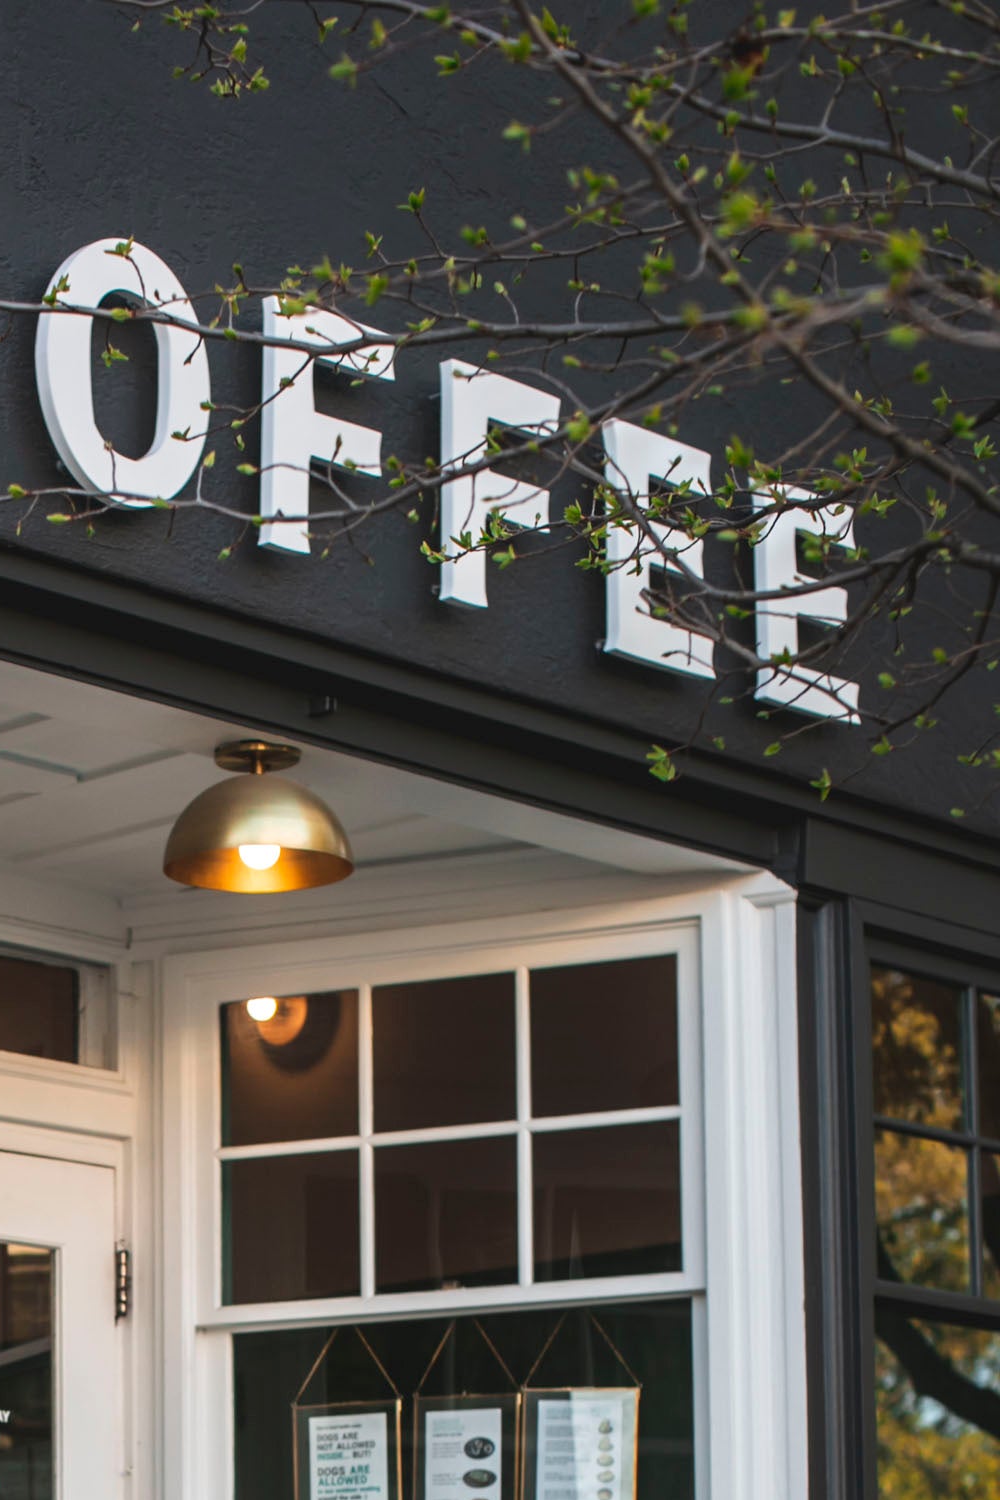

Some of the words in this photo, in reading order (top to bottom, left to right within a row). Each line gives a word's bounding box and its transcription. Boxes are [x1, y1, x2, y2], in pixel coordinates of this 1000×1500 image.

[317, 1432, 339, 1441] DOGS
[342, 1431, 359, 1440] ARE
[317, 1442, 333, 1451] NOT
[337, 1440, 376, 1450] ALLOWED
[317, 1466, 346, 1476] DOGS
[350, 1464, 370, 1474] ARE
[318, 1475, 368, 1486] ALLOWED
